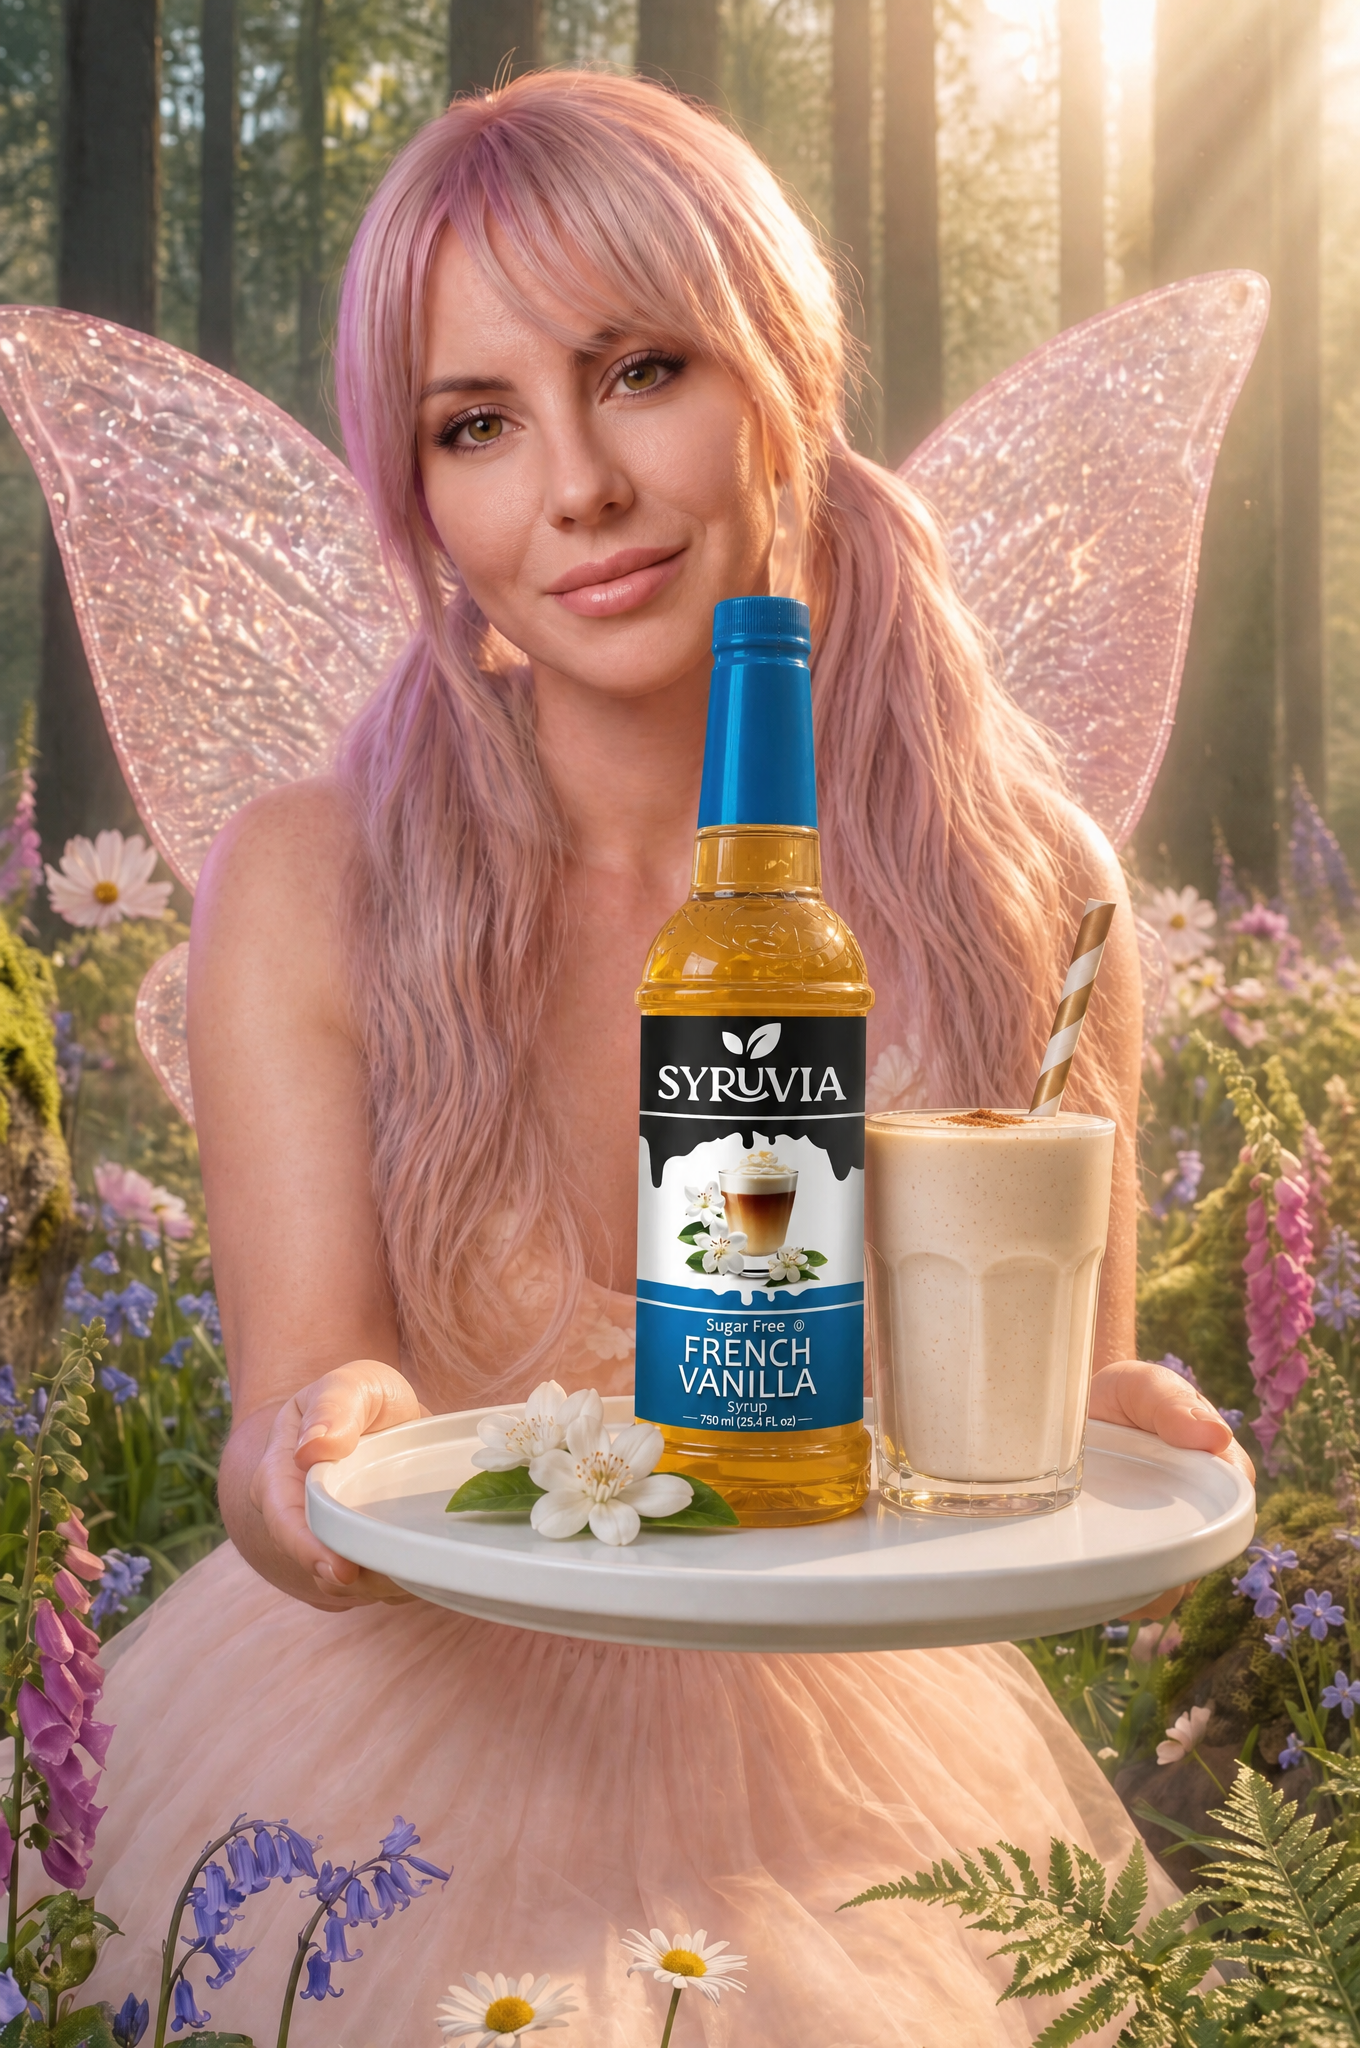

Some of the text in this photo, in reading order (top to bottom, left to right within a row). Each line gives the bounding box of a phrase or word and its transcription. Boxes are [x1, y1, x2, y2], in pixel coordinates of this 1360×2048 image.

[658, 1064, 847, 1103] SYRUVIA
[706, 1318, 785, 1337] Sugar Free
[684, 1335, 811, 1367] FRENCH
[678, 1364, 818, 1398] VANILLA
[727, 1400, 768, 1416] Syrup
[700, 1414, 796, 1429] 750 ml (25.4 FL oz)
